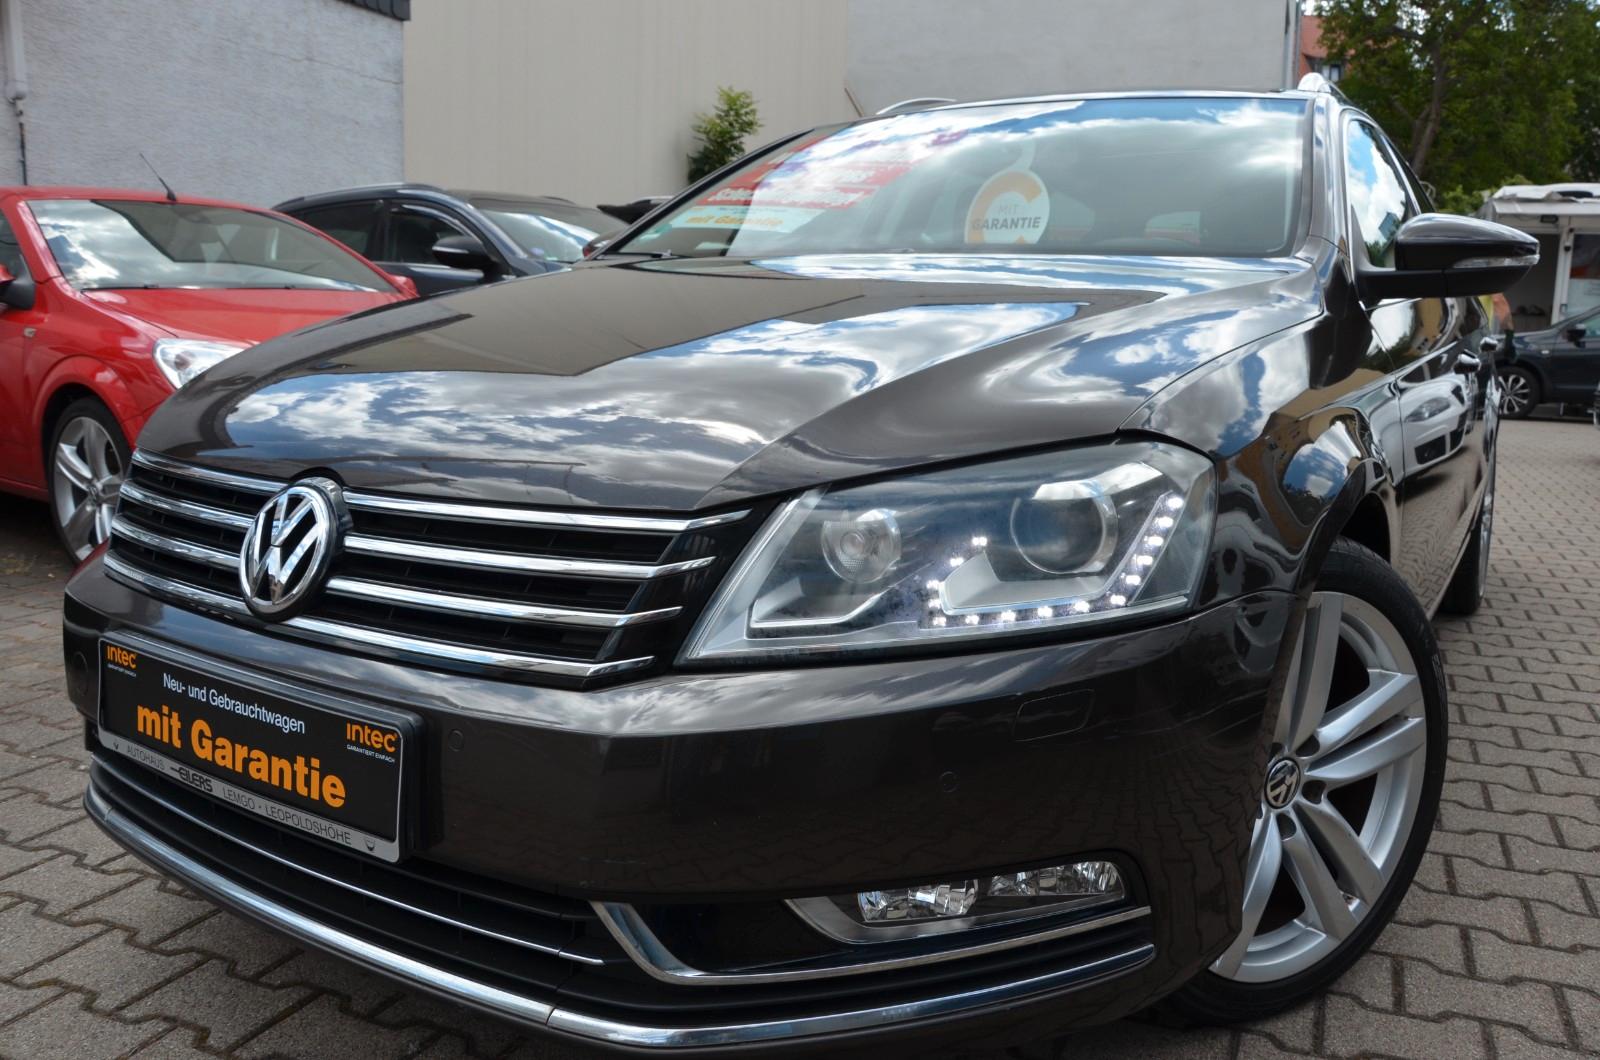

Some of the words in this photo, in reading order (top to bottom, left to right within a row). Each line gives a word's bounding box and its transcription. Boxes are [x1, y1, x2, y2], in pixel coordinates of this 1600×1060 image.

[972, 216, 1041, 231] GARANTIE
[163, 672, 186, 693] Neu-
[188, 686, 207, 702] und
[209, 689, 305, 734] Gebrauchtwagen
[126, 745, 166, 772] AUTOHAUS
[222, 786, 256, 811] LEMGO
[265, 803, 352, 846] LEOPOLDSHÖHE
[137, 704, 182, 749] mit
[190, 719, 346, 808] Garantie
